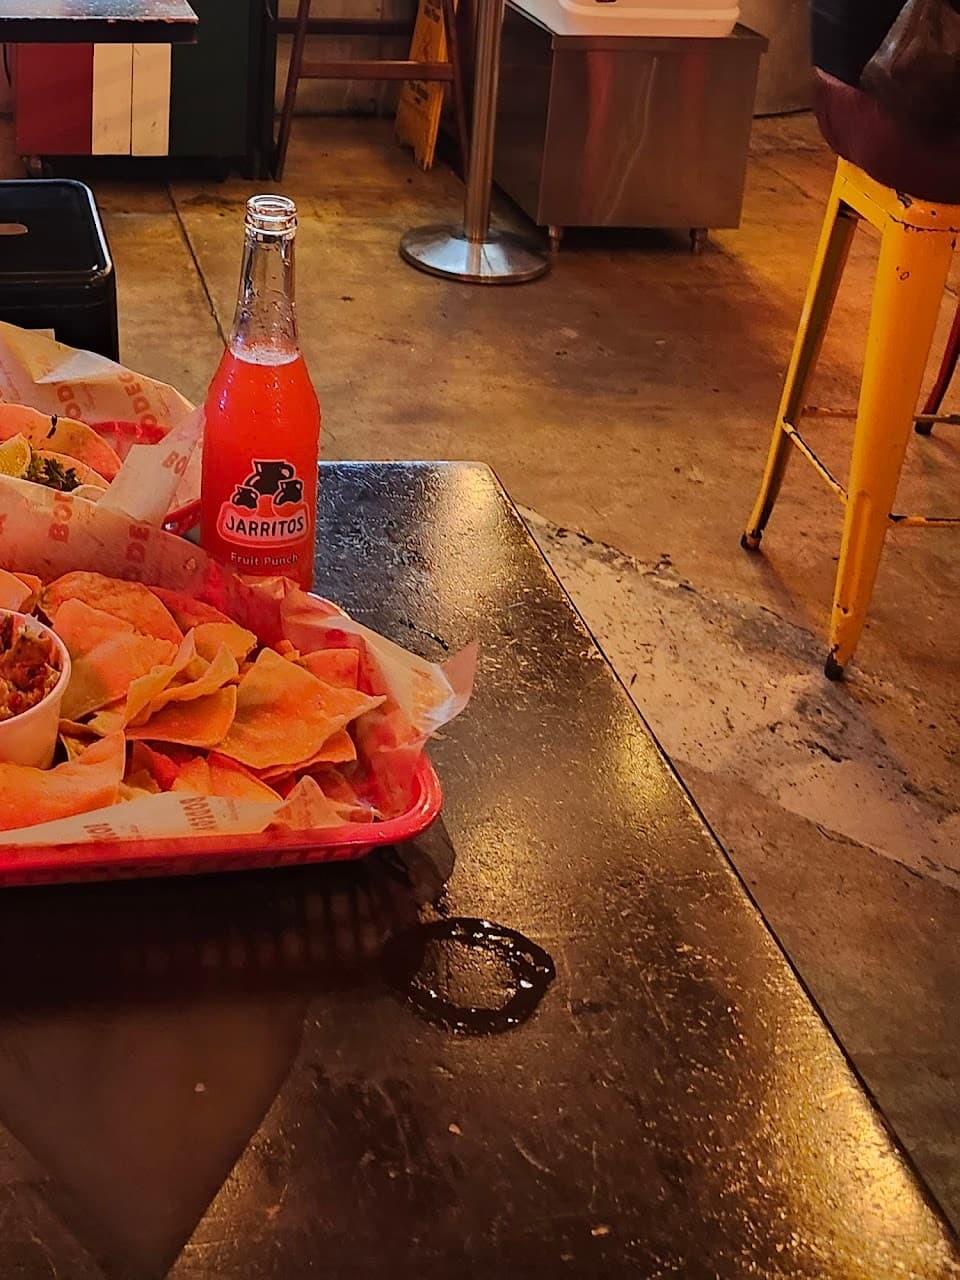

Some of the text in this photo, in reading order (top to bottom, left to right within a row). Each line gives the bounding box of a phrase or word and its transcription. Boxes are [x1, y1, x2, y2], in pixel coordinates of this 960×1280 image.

[226, 516, 303, 536] JARRITOS
[231, 552, 298, 566] Fruit Punch
